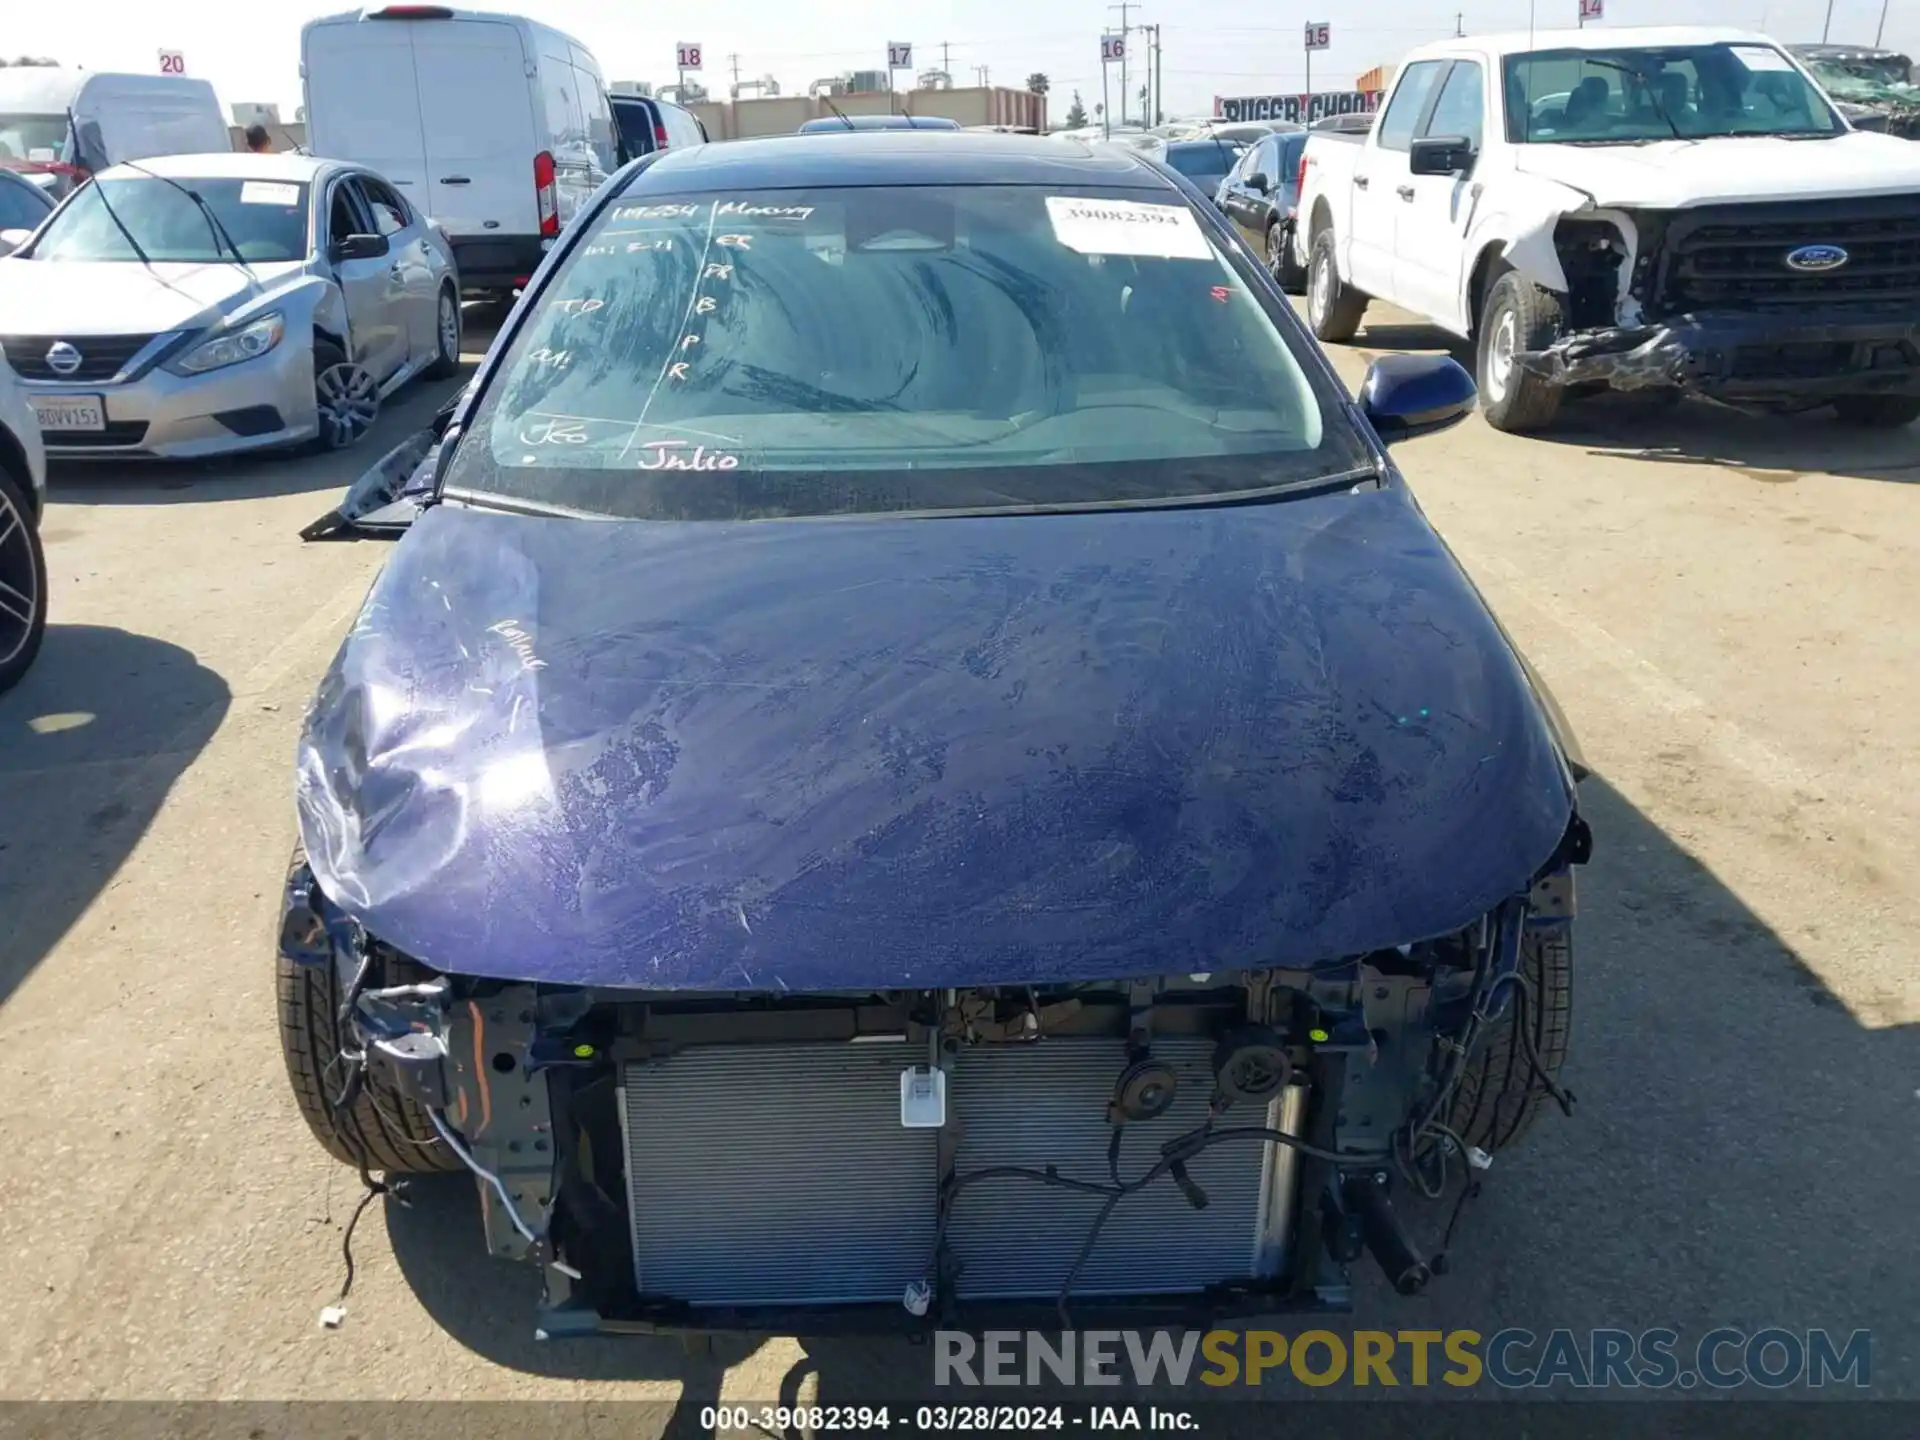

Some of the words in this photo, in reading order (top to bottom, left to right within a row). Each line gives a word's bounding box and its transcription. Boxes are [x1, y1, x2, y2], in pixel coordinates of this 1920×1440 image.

[1580, 0, 1602, 15] 14
[1306, 26, 1329, 47] 15
[677, 48, 701, 66] 18
[888, 47, 911, 65] 17
[1102, 40, 1124, 58] 16
[160, 55, 184, 73] 20
[1066, 208, 1179, 226] 39082394
